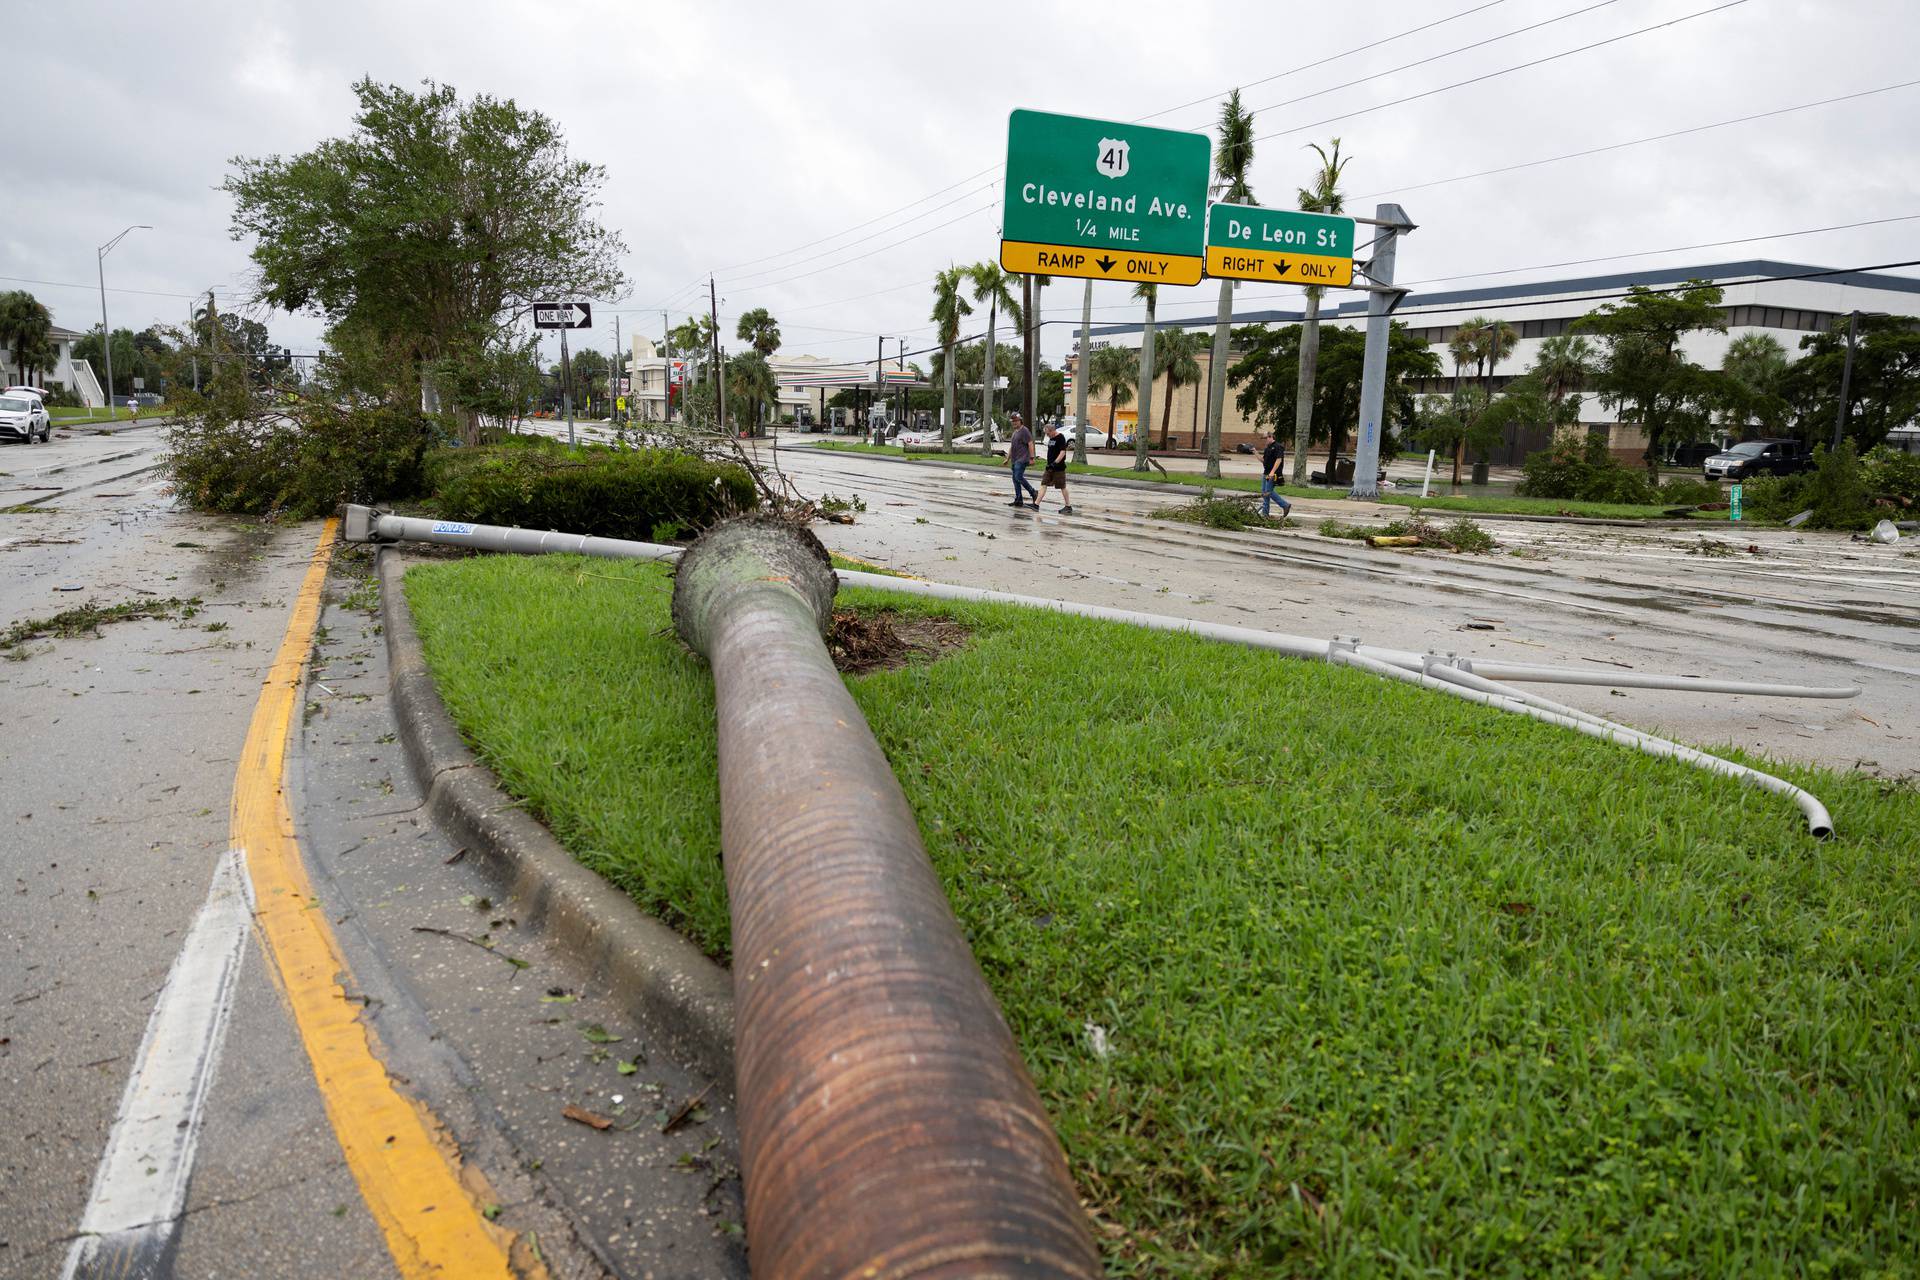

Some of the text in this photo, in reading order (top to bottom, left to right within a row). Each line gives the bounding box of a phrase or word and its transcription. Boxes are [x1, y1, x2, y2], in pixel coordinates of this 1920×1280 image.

[1102, 148, 1124, 171] 41
[1022, 183, 1192, 220] Cleveland Ave.
[1076, 218, 1140, 241] 1/4 MILE
[1228, 219, 1337, 248] De Leon St
[1038, 252, 1169, 276] RAMP ONLY
[1222, 256, 1337, 278] RIGHT ONLY
[539, 311, 555, 321] ONE
